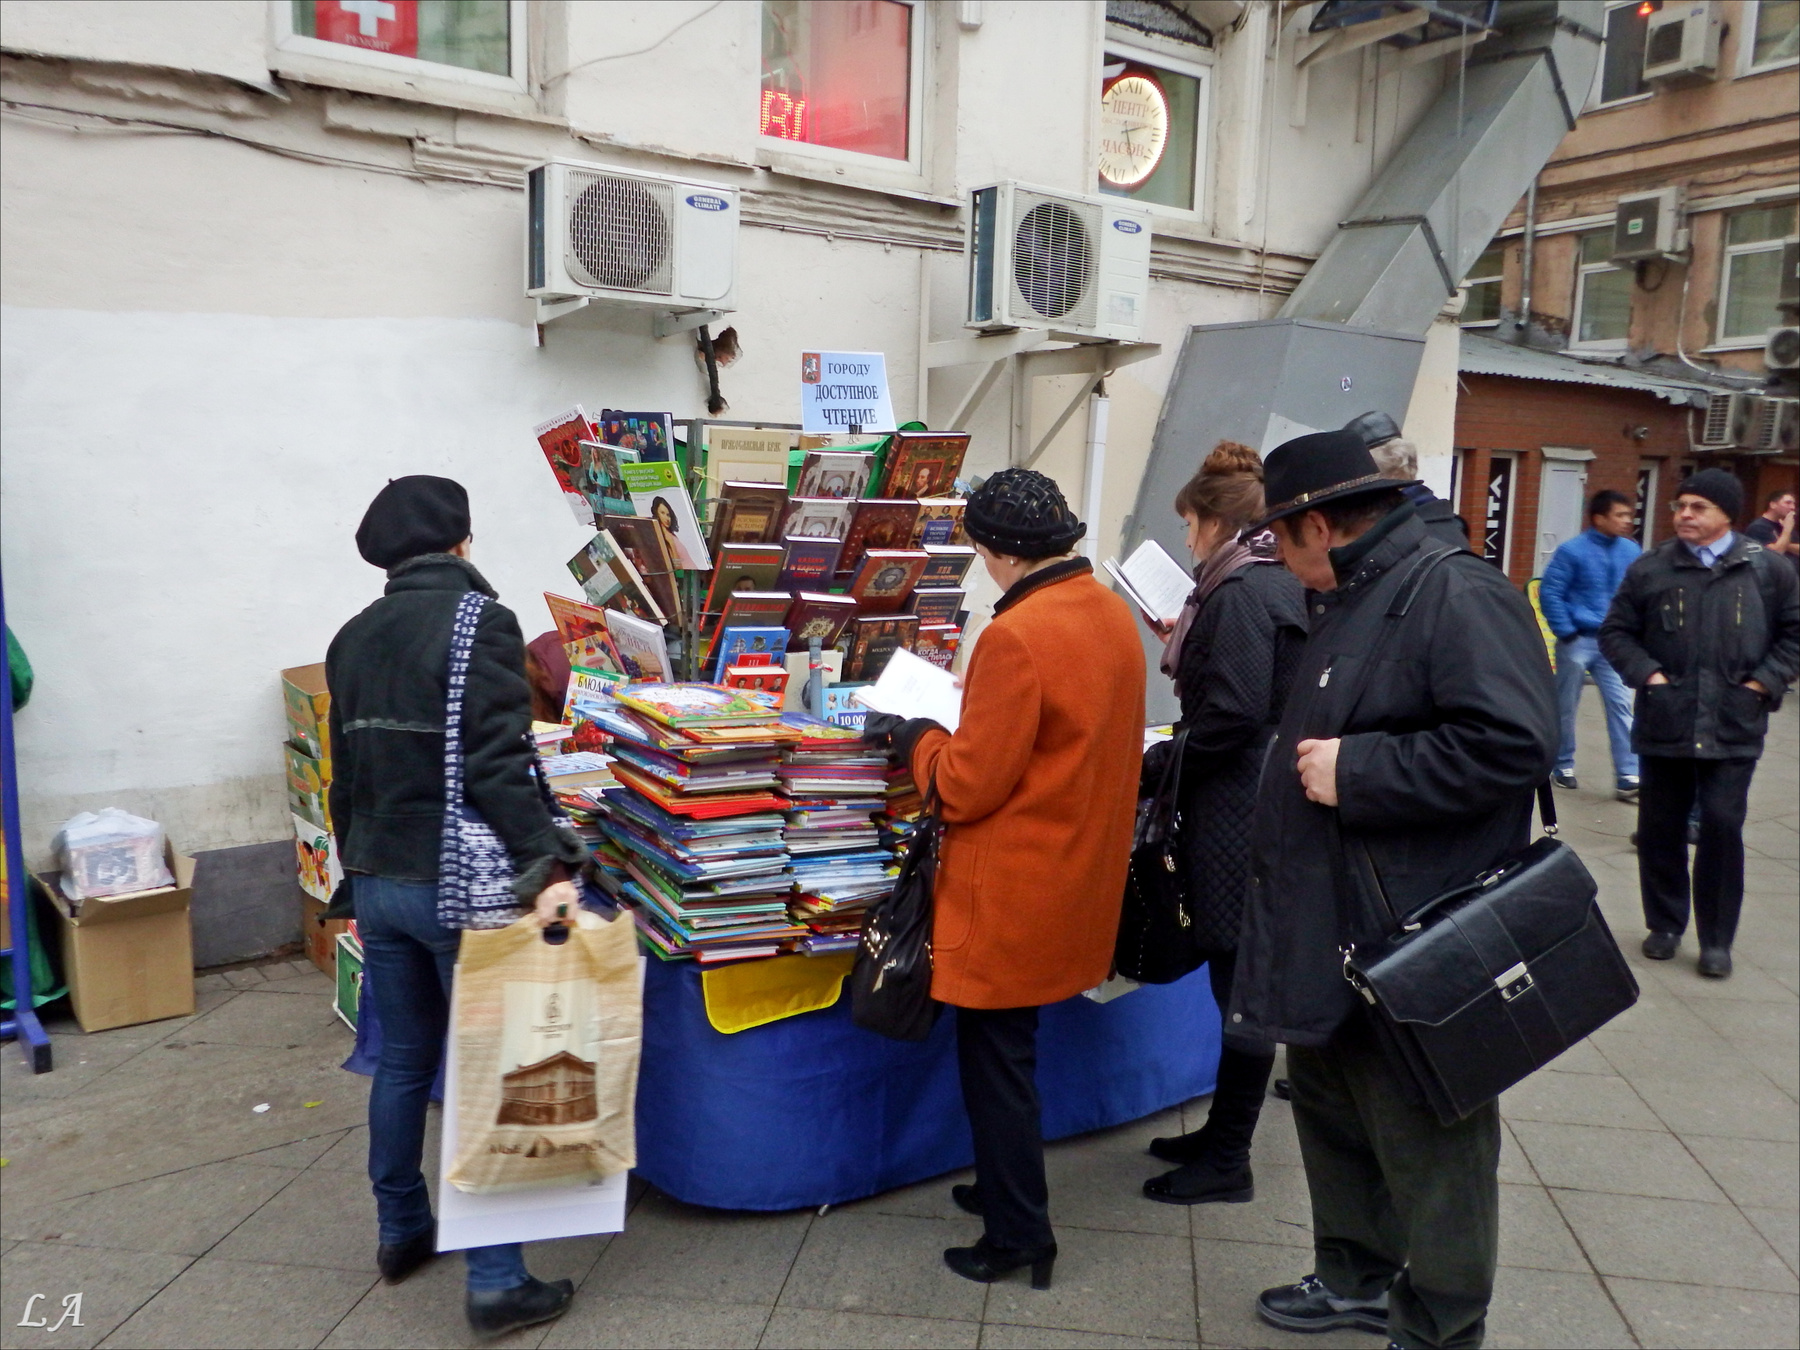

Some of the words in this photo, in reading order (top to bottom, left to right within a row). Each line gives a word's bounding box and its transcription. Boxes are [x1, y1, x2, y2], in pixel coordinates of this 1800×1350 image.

[1112, 100, 1150, 118] ЦЕНТР
[1102, 139, 1145, 157] ЧАСОВ
[693, 196, 722, 205] GENERAL
[694, 202, 721, 210] CLIMATE
[828, 362, 871, 377] ГОРОДУ
[815, 384, 879, 402] ДОСТУПНОЕ
[822, 408, 878, 425] ЧТЕНИЕ
[917, 648, 939, 656] КОГДА
[853, 715, 867, 725] 00
